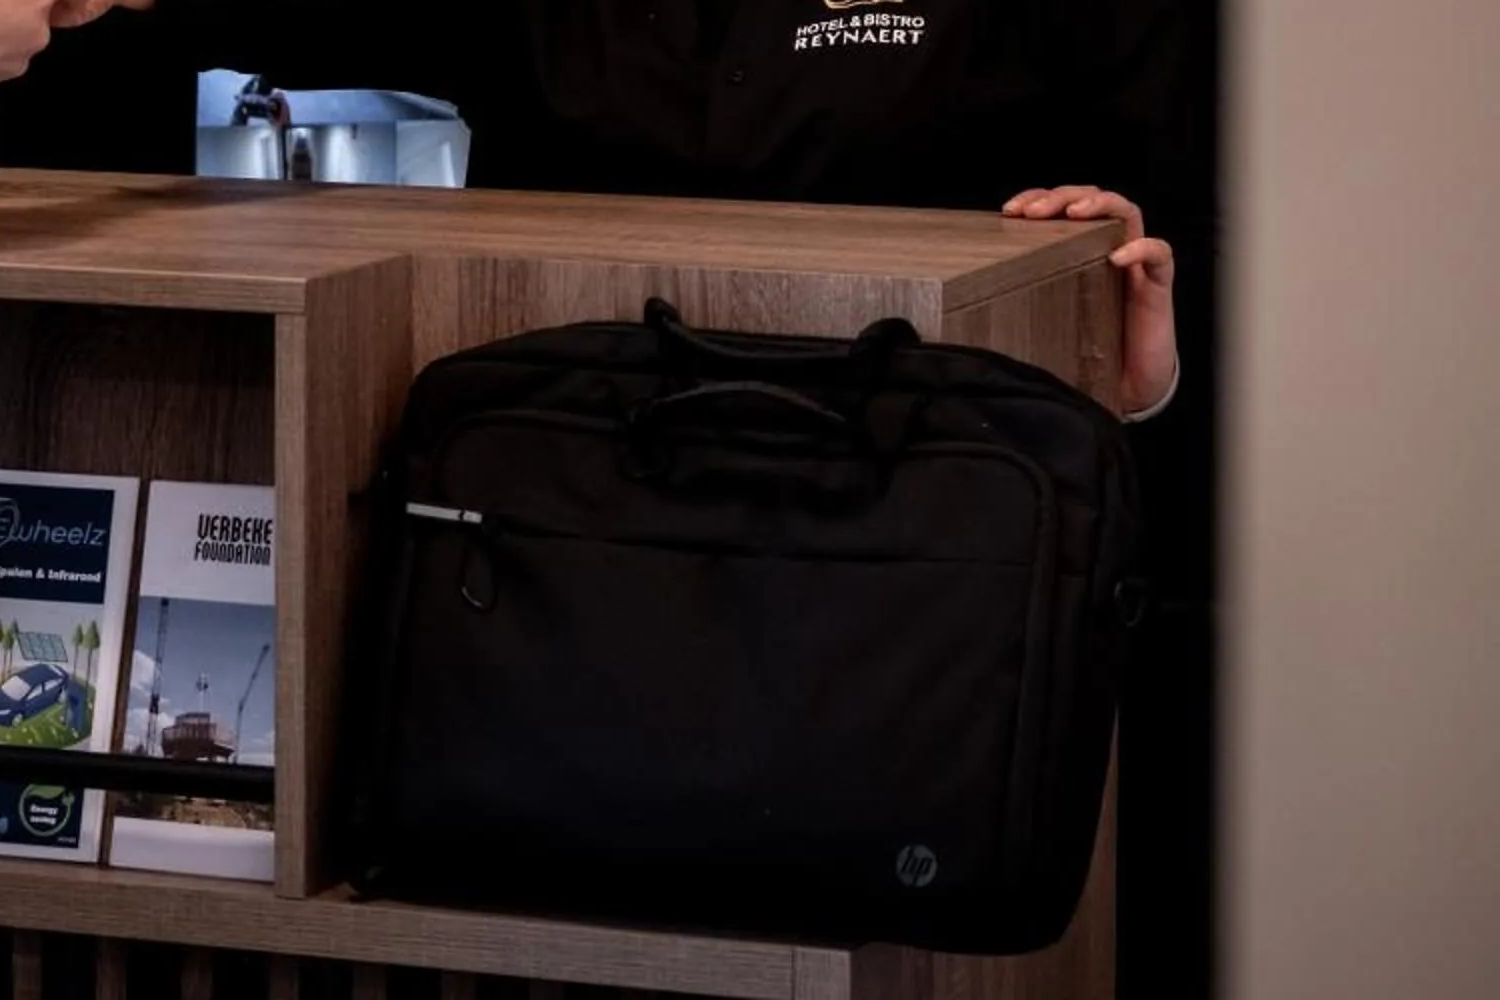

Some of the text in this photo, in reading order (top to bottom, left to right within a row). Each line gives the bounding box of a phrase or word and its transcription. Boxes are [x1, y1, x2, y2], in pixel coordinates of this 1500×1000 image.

[796, 13, 925, 36] HOTEL & BISTRO
[794, 29, 924, 50] REYNAERT
[197, 514, 273, 545] VERBEKE
[194, 541, 271, 566] FOUNDATION
[899, 845, 935, 887] hp
